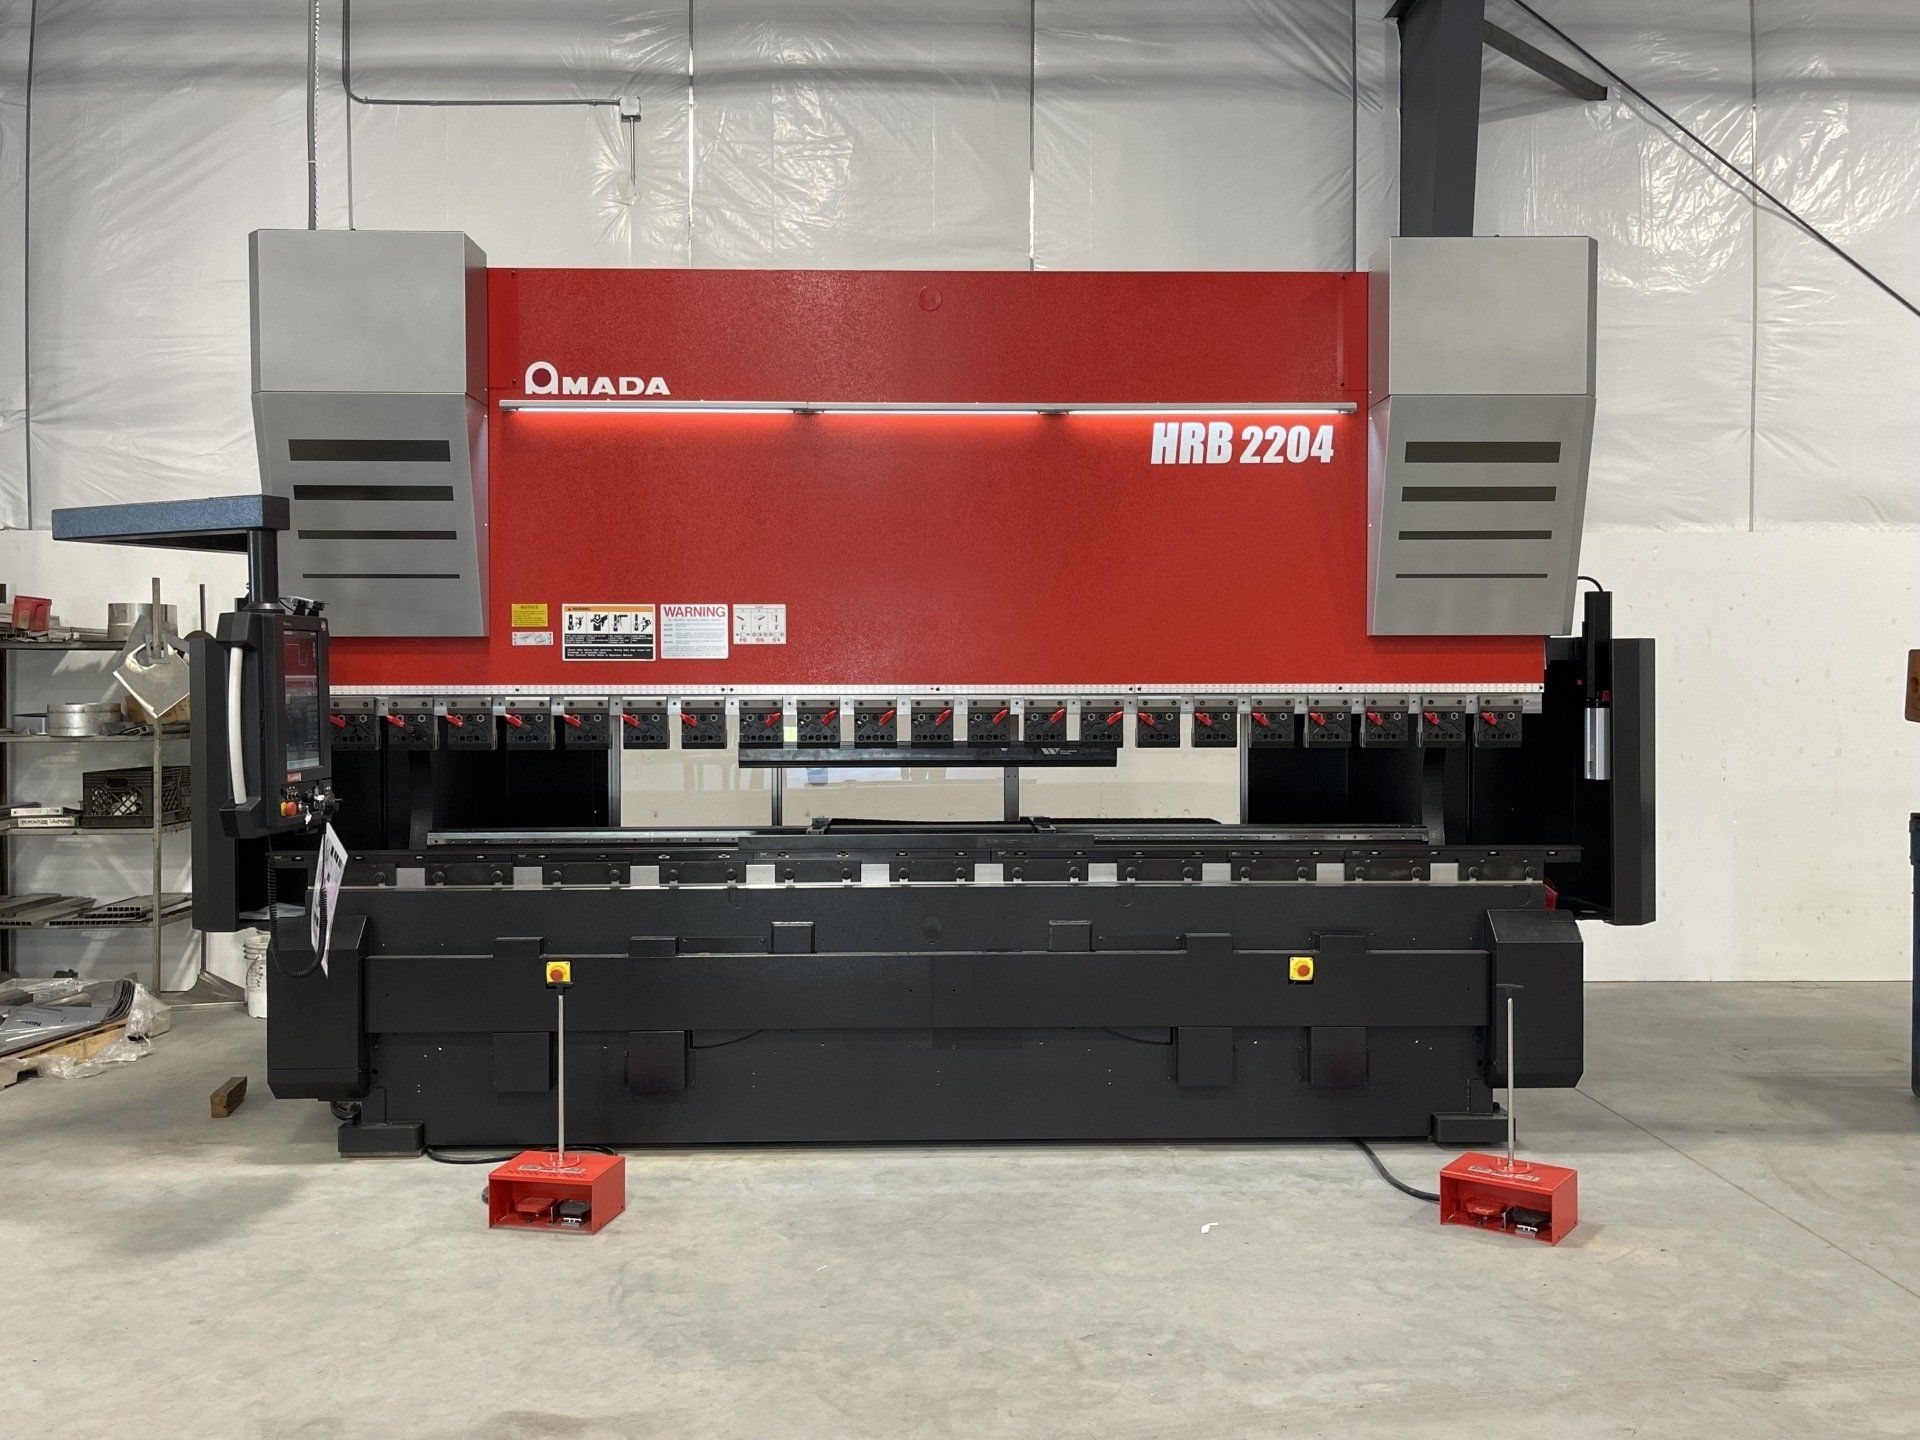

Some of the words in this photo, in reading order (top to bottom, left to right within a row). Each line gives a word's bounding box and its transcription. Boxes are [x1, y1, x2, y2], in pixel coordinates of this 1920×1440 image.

[524, 360, 671, 395] AMADA
[1150, 421, 1233, 465] HRB
[1239, 425, 1334, 463] 2204
[663, 606, 726, 618] WARNING
